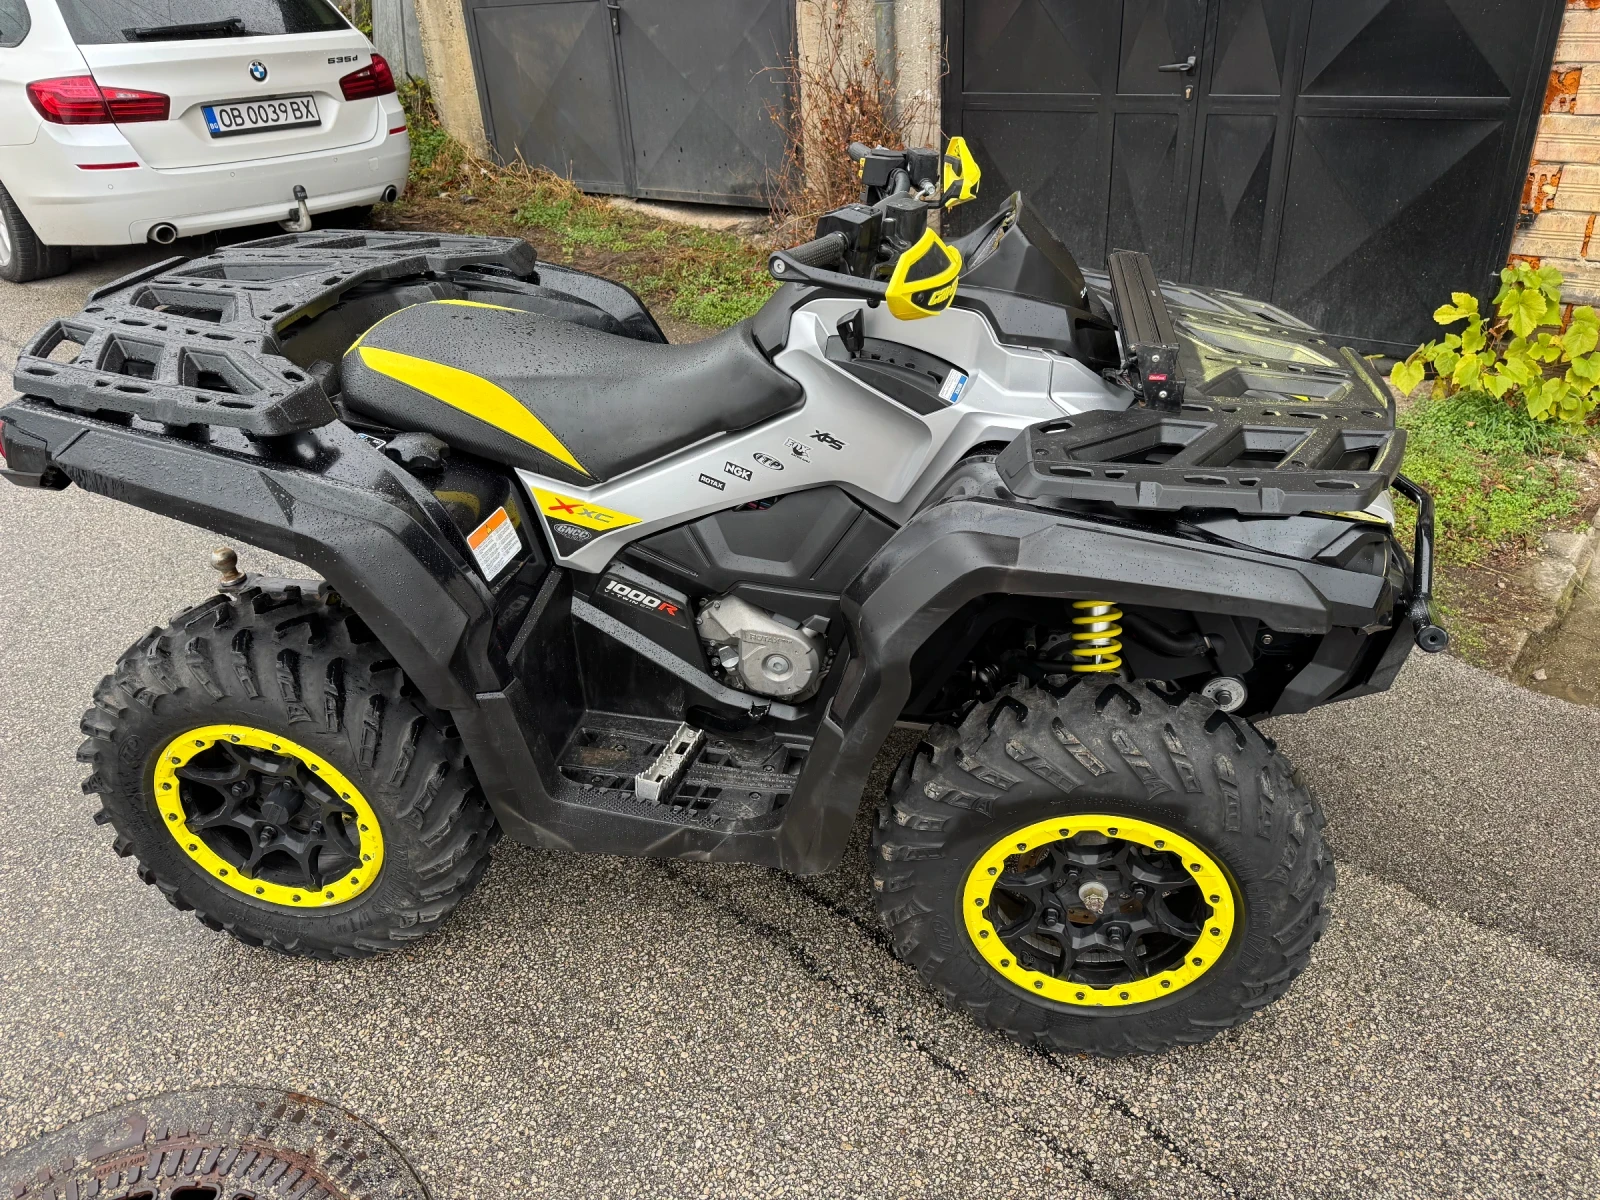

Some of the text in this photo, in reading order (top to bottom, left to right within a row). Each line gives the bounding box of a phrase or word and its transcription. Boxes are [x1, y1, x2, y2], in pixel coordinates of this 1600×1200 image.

[328, 55, 358, 64] 535d
[219, 99, 315, 128] OB 0039 BX
[784, 438, 812, 458] FOX
[810, 430, 846, 451] XPS
[755, 453, 782, 469] ITP
[726, 463, 752, 481] NGK
[700, 475, 724, 490] ROTAX
[557, 524, 589, 539] GNCC
[605, 580, 678, 616] 1000R
